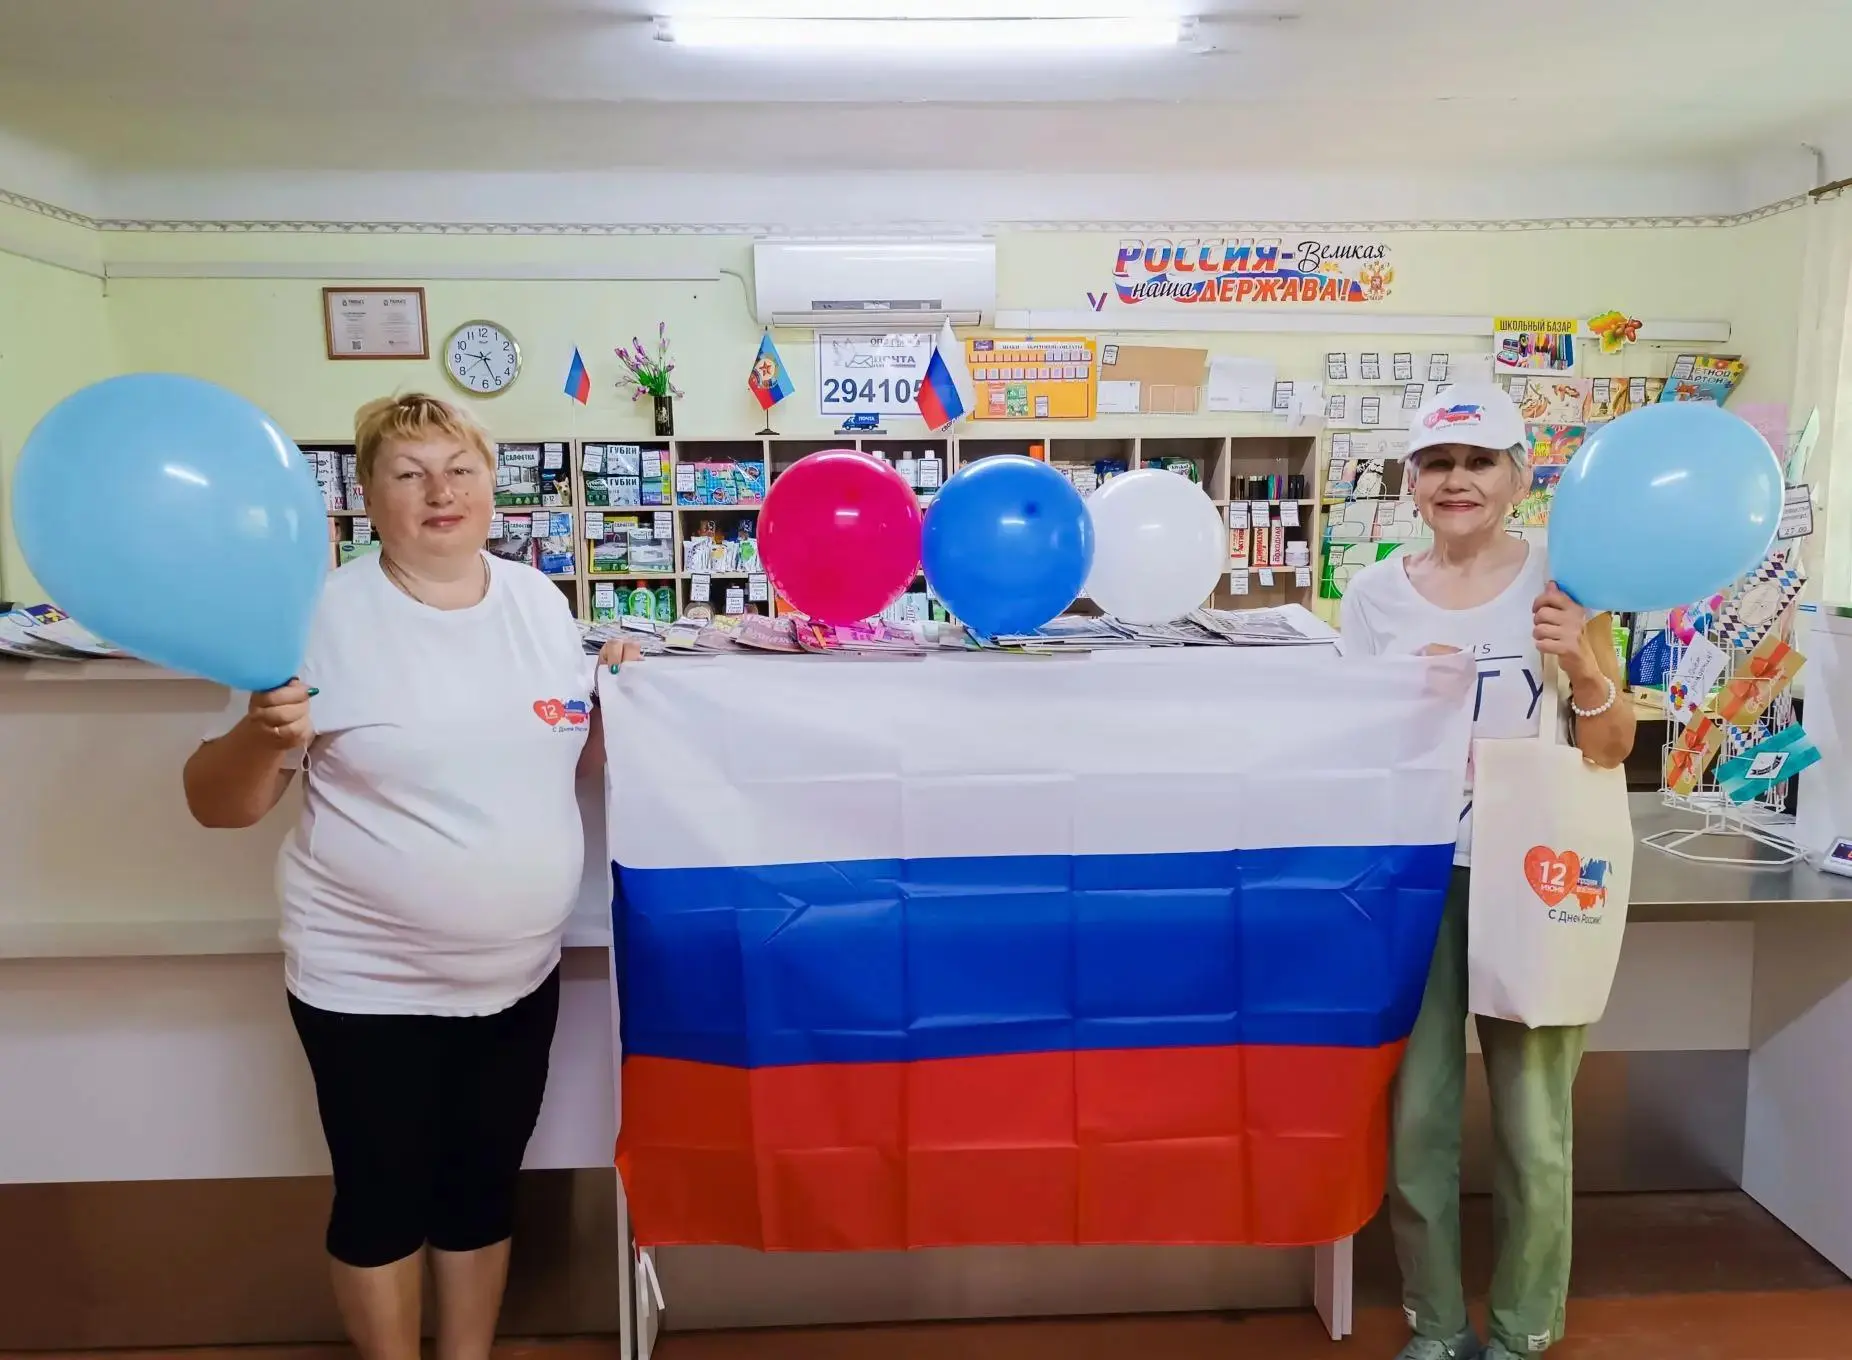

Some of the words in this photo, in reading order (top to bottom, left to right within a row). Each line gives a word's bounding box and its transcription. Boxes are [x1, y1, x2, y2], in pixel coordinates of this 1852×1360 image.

[1298, 241, 1385, 273] Великая
[1132, 282, 1194, 298] наша
[1200, 278, 1351, 301] ДЕРЖАВА!
[1500, 319, 1545, 331] ШКОЛЬНЫЙ
[1547, 321, 1572, 332] БАЗАР
[467, 331, 475, 340] 11
[479, 328, 488, 338] 12
[457, 341, 467, 350] 10
[503, 341, 510, 351] 2
[454, 354, 462, 363] 9
[507, 354, 515, 364] 3
[459, 366, 466, 376] 8
[504, 367, 510, 376] 4
[469, 376, 475, 385] 7
[482, 380, 489, 389] 6
[495, 376, 502, 386] 5
[609, 446, 637, 455] ГУБКИ
[609, 478, 637, 486] ГУБКИ
[541, 704, 559, 719] 12
[1540, 861, 1567, 887] 12
[1548, 908, 1557, 920] С
